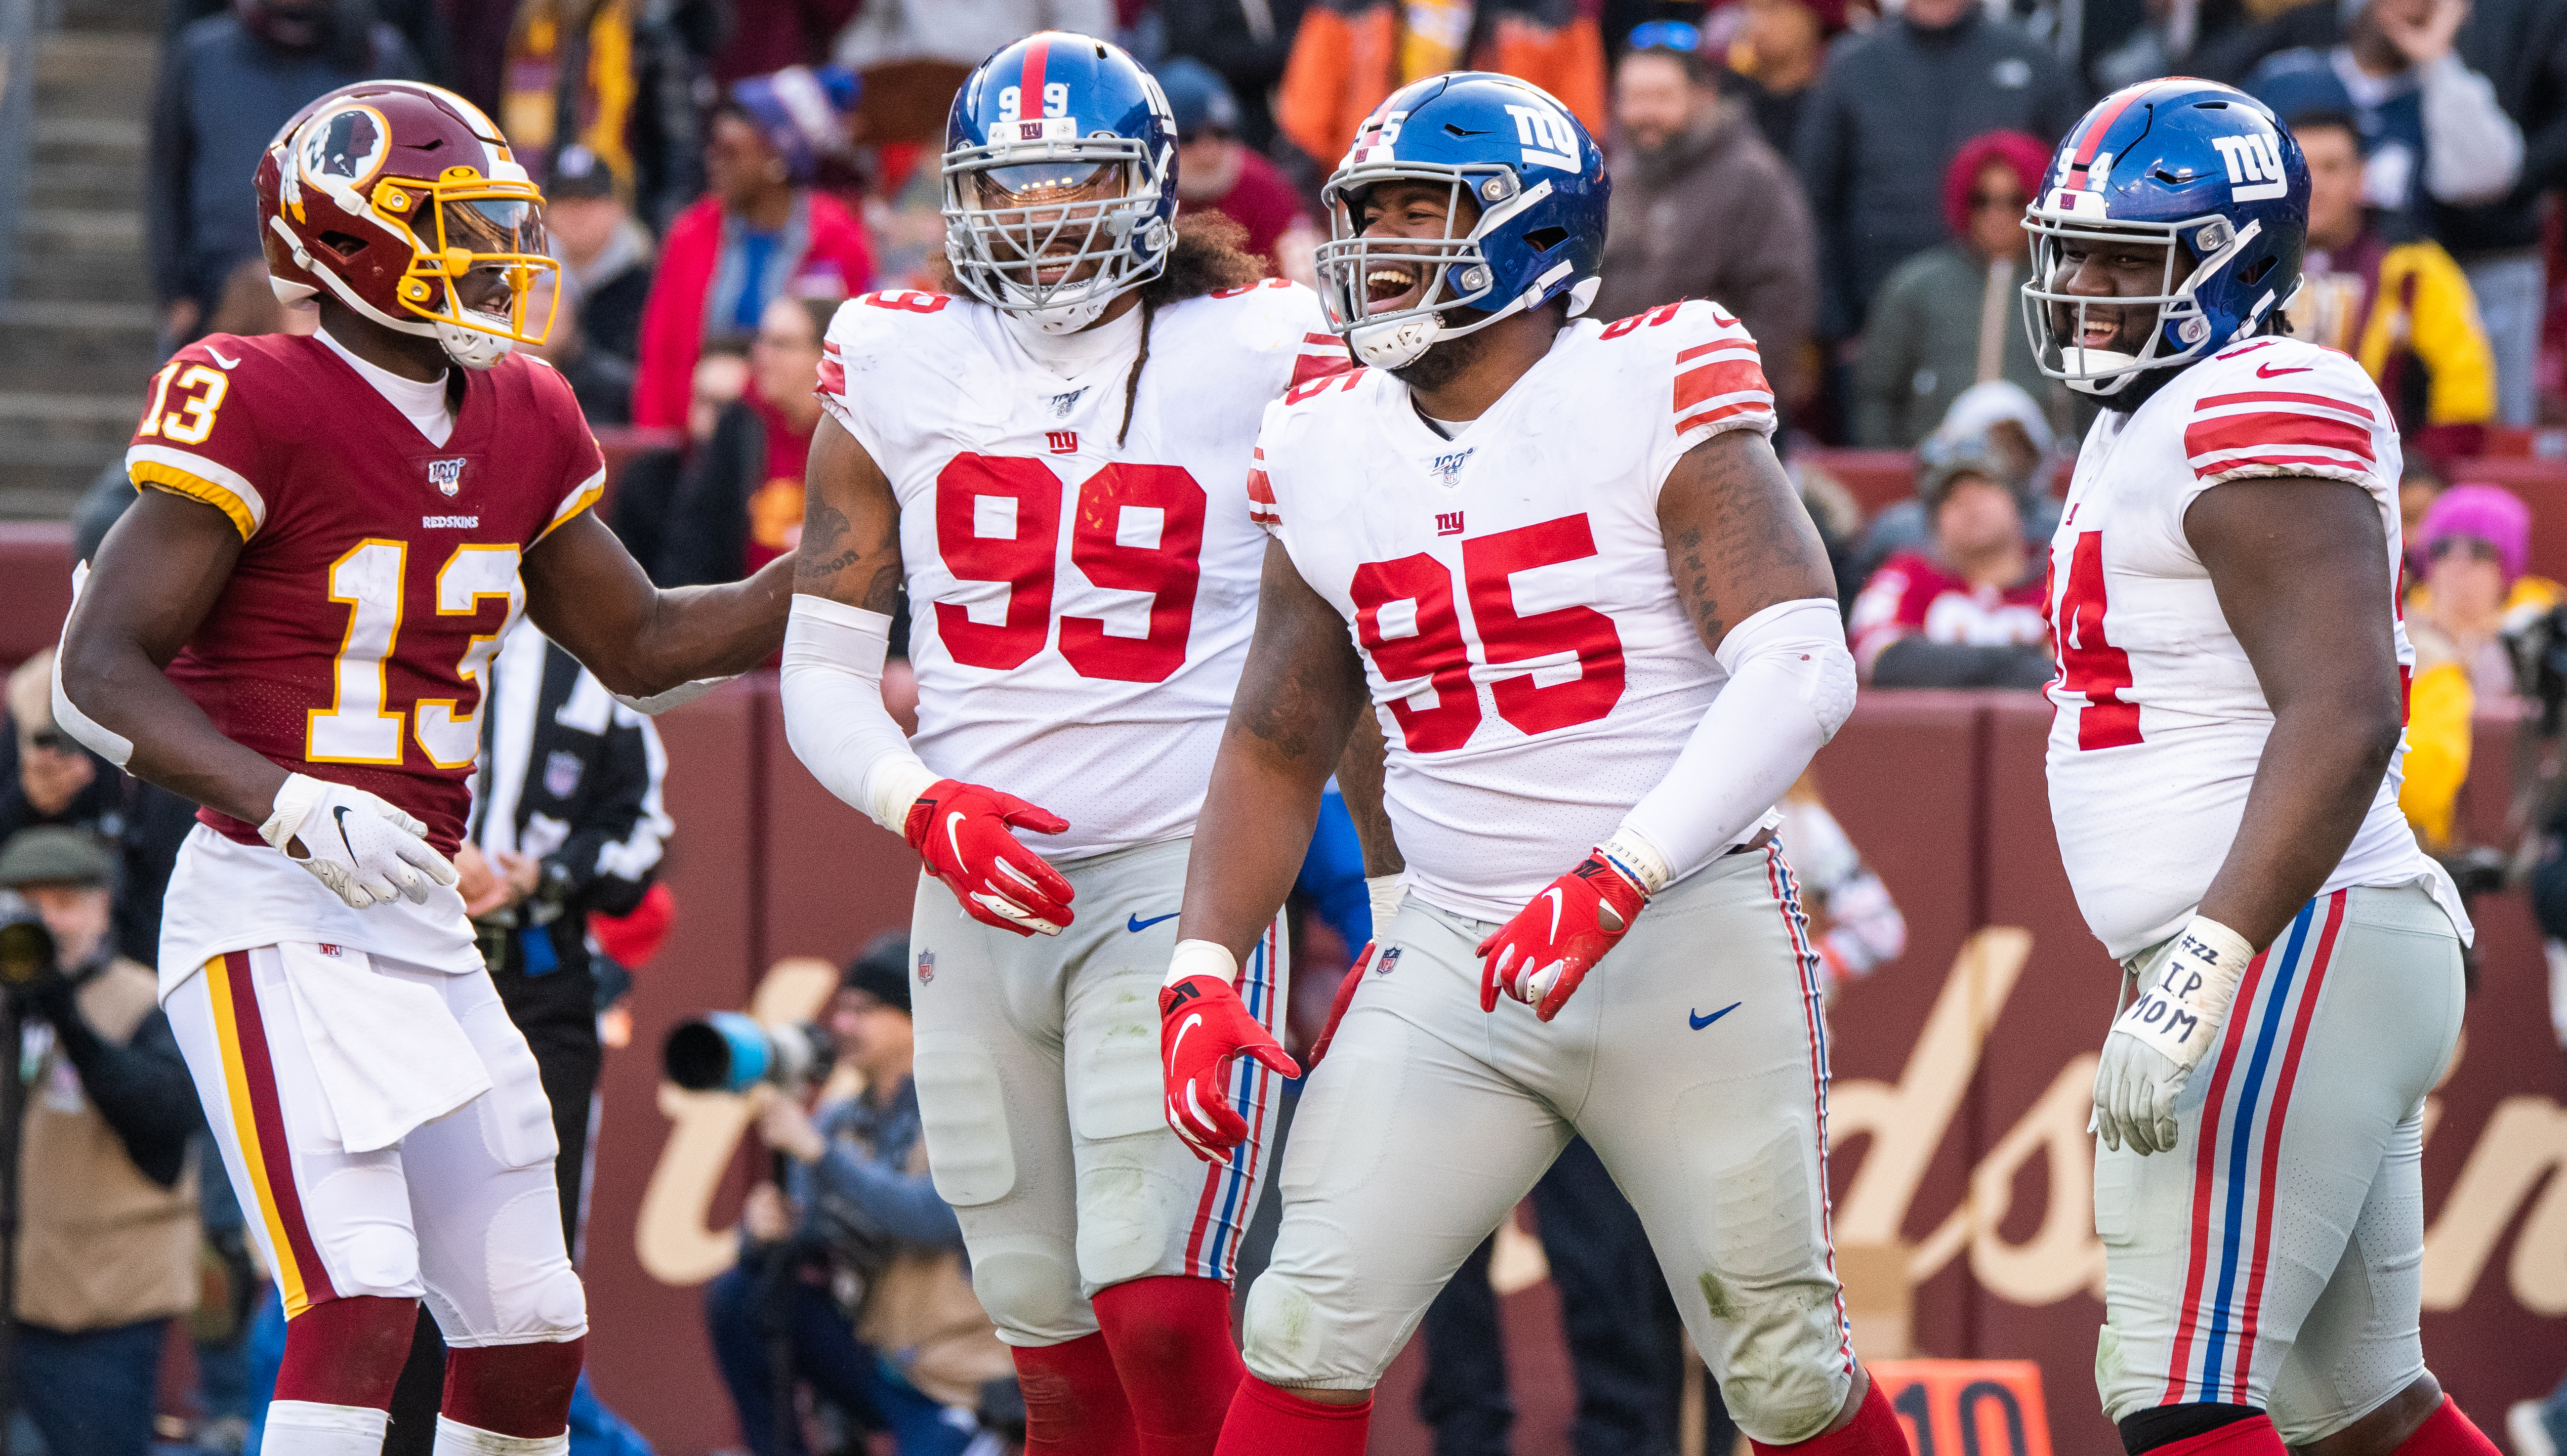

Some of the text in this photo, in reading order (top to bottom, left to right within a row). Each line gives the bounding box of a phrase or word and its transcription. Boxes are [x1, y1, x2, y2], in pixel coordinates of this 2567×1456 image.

[999, 82, 1068, 122] 99
[1019, 122, 1042, 140] ny
[1504, 104, 1582, 174] ny
[2054, 147, 2113, 193] 94
[2212, 134, 2288, 202] ny
[139, 362, 229, 445] 13
[1045, 432, 1078, 454] ny
[422, 516, 478, 528] REDSKINS
[1435, 511, 1464, 536] ny
[933, 451, 1207, 683] 99
[306, 537, 527, 769] 13
[1350, 512, 1625, 753] 95
[1896, 1383, 2024, 1456] 10
